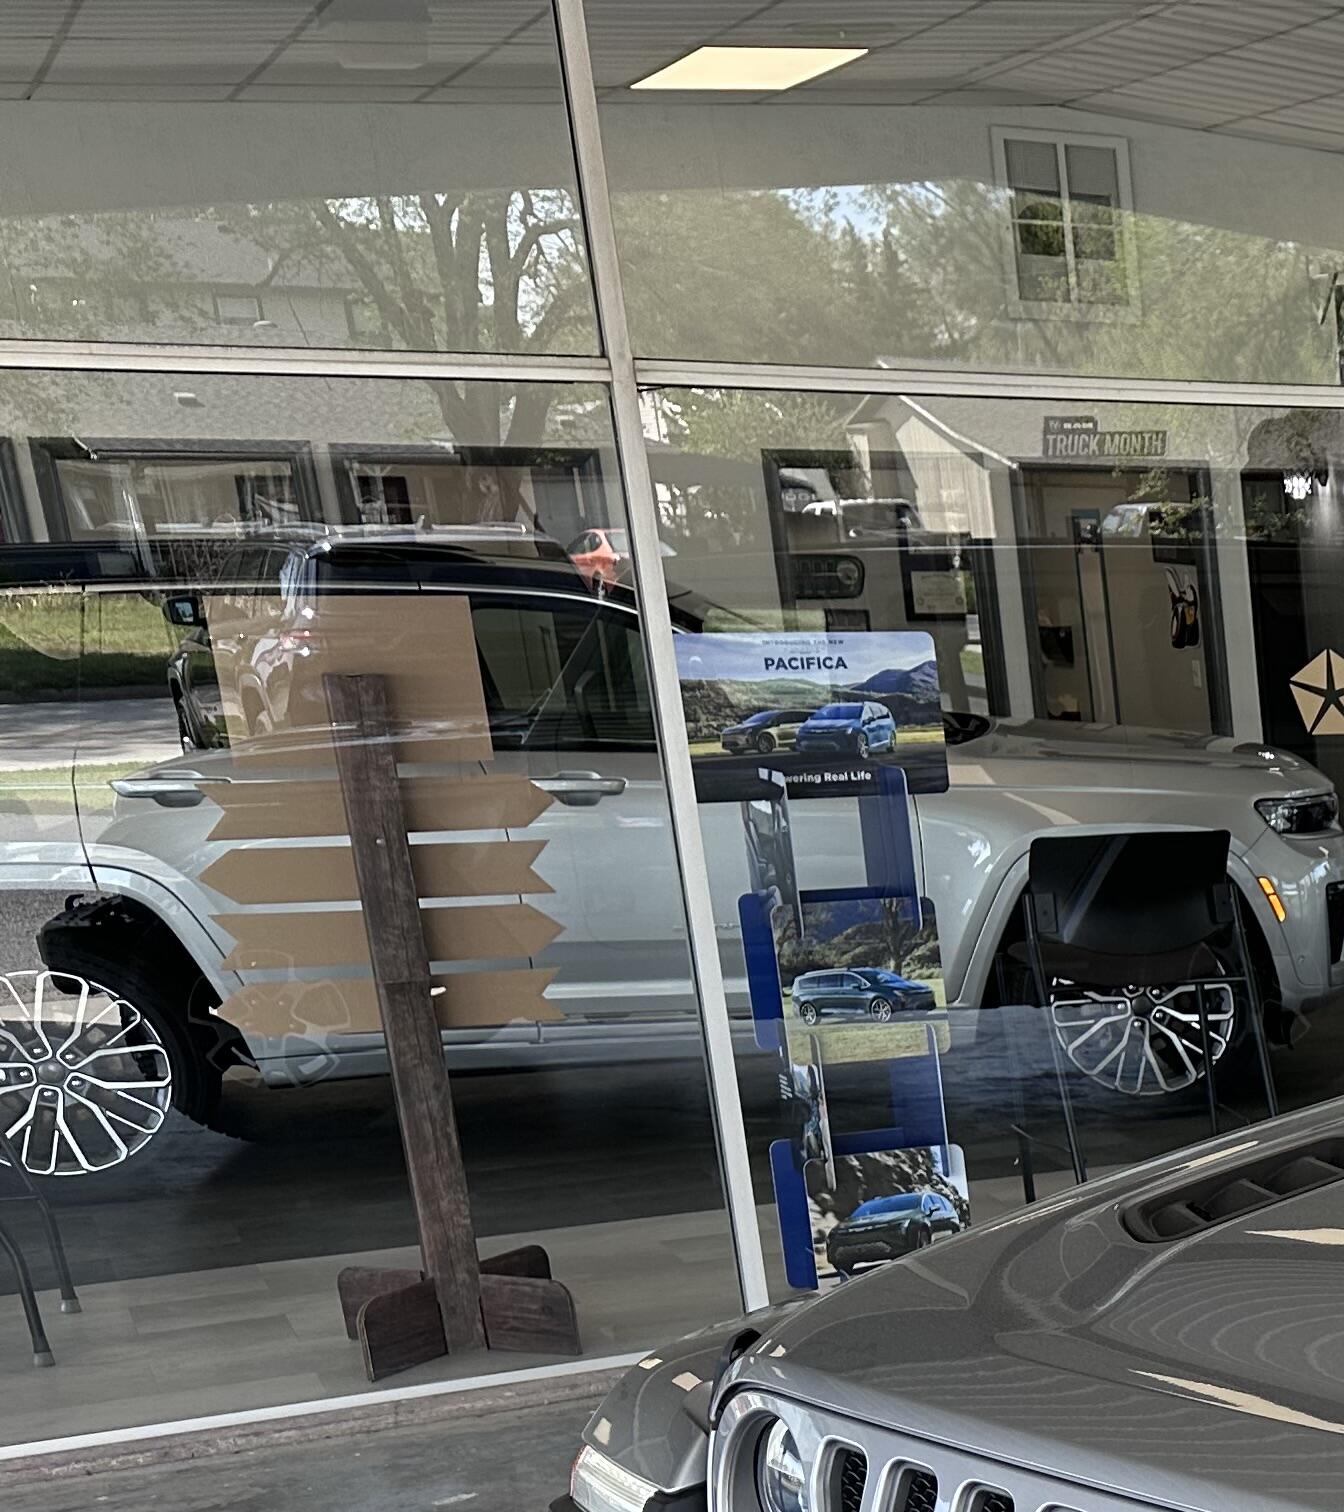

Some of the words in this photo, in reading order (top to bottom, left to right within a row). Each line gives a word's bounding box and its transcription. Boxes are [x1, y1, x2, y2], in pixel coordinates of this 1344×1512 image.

[1046, 433, 1099, 456] TRUCK
[1103, 433, 1163, 456] MONTH
[764, 656, 848, 671] PACIFICA
[824, 772, 848, 782] Real
[850, 770, 872, 781] Life
